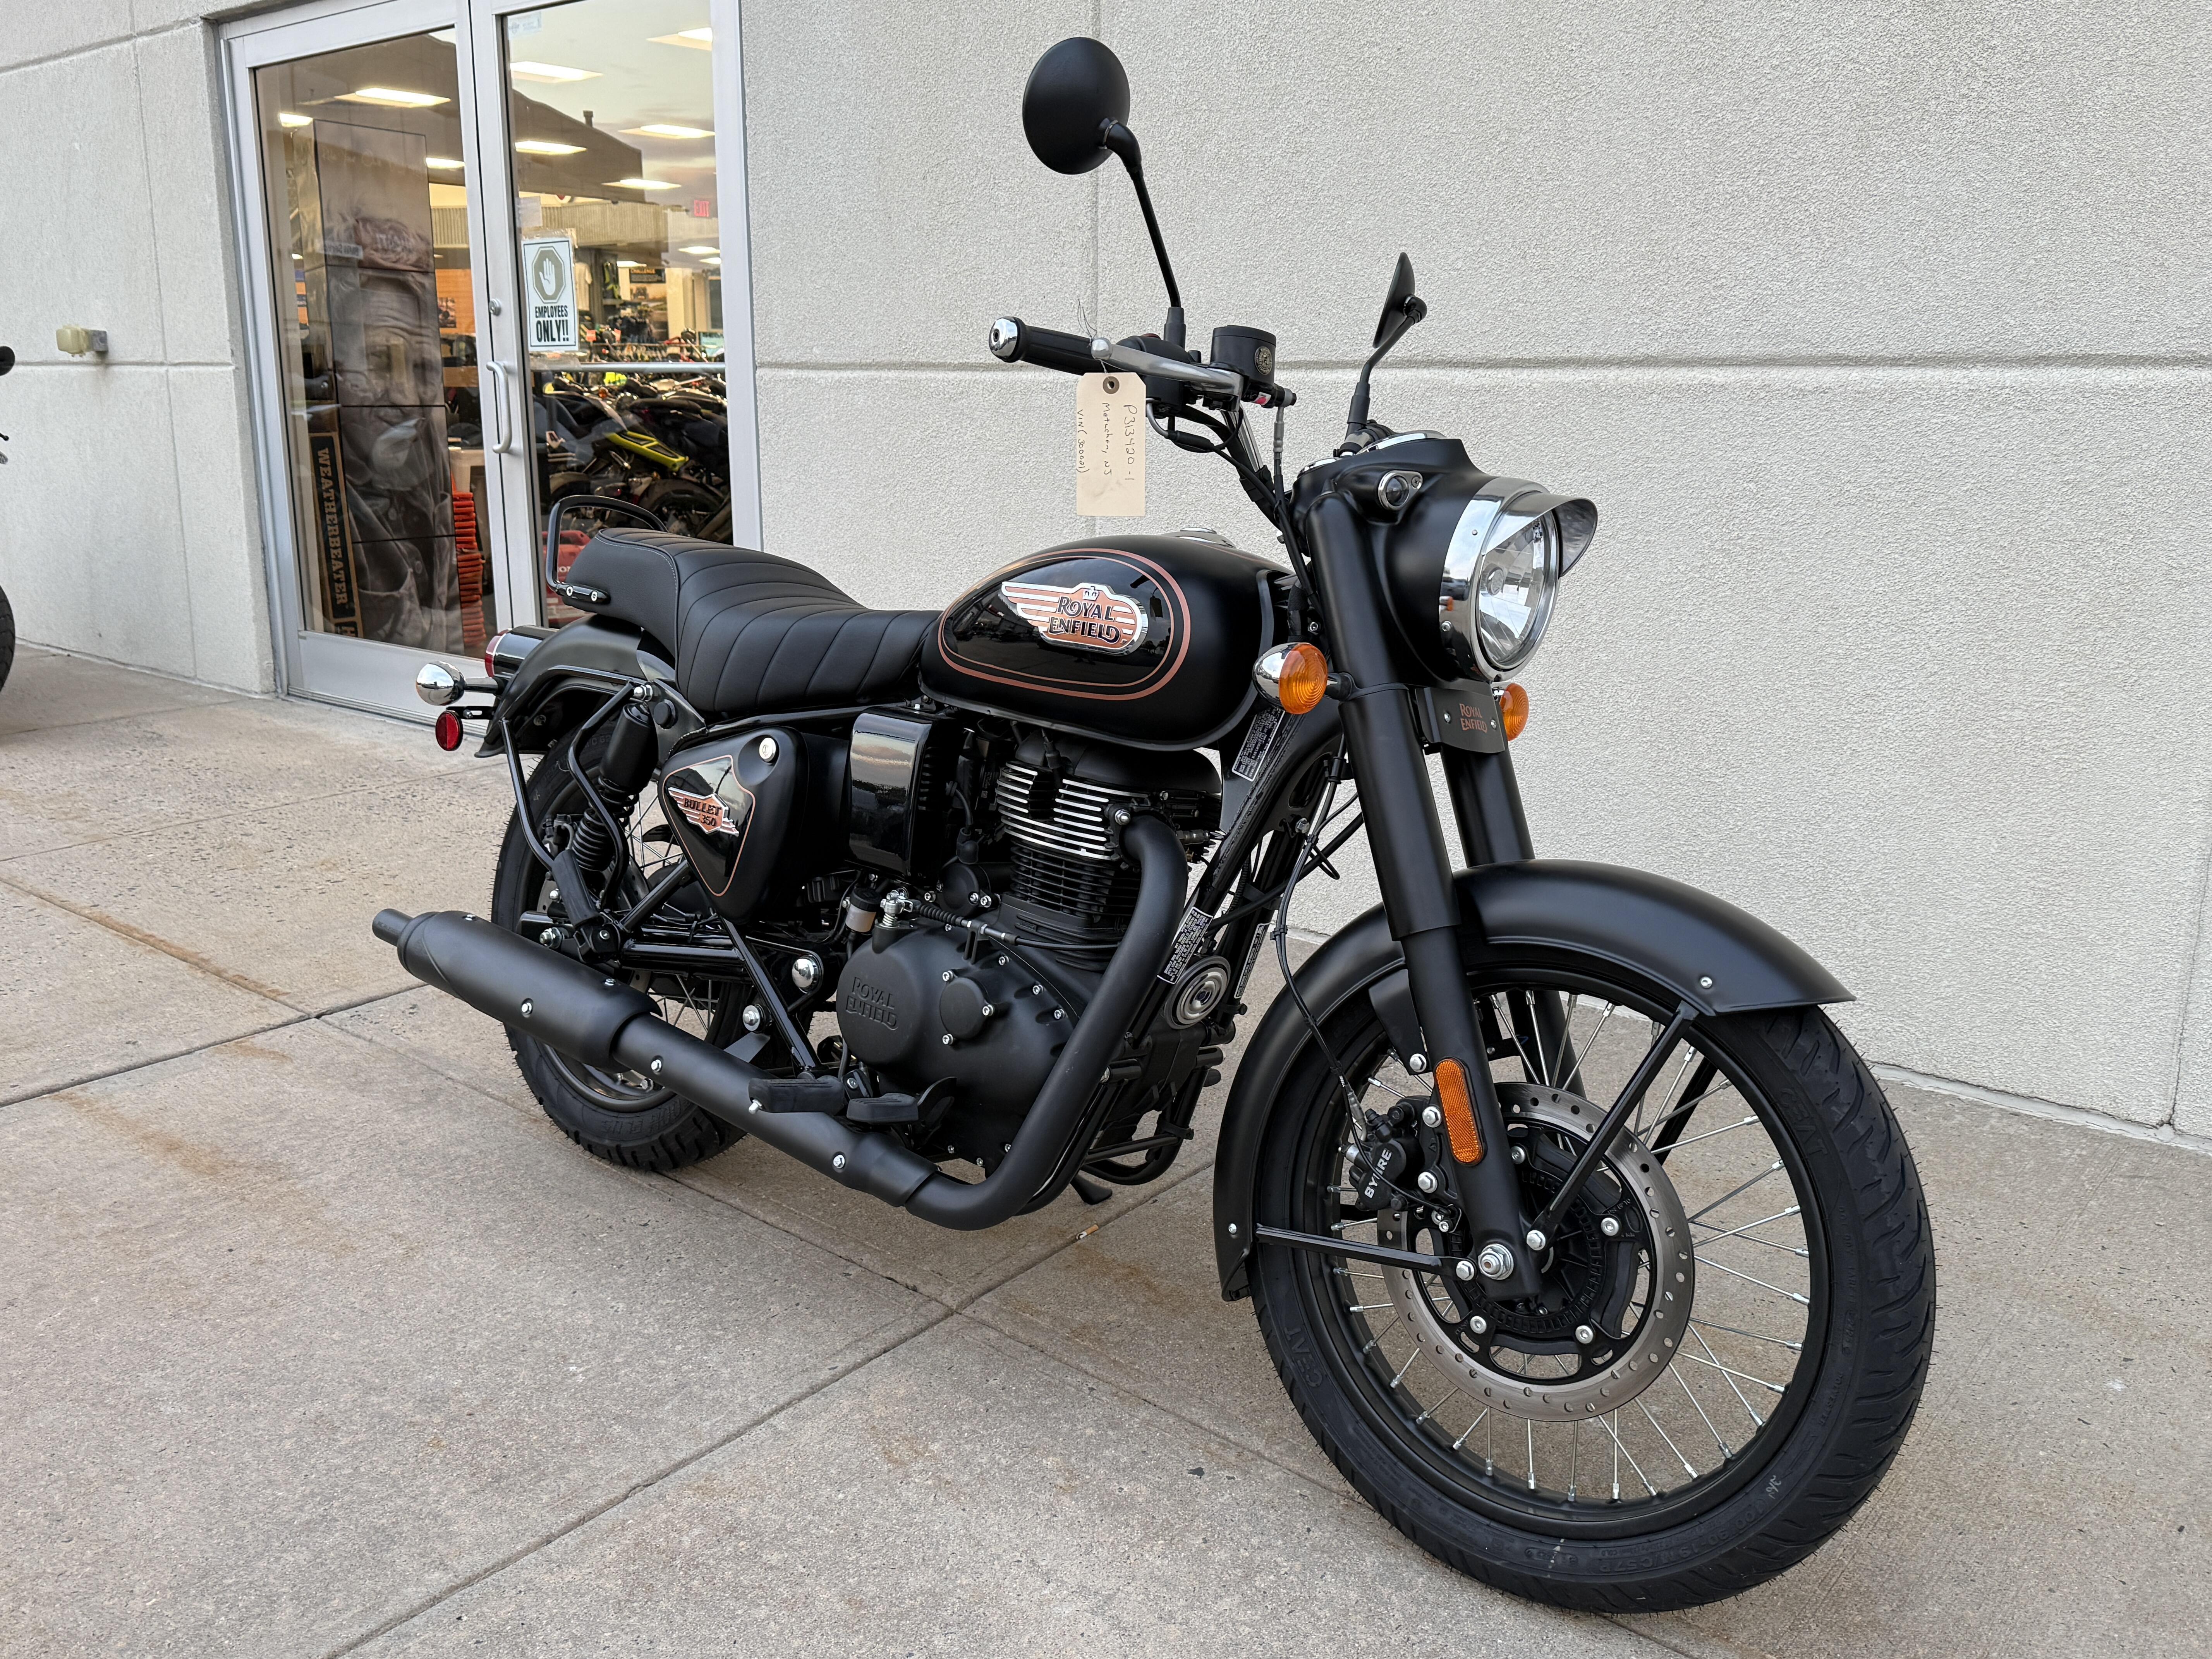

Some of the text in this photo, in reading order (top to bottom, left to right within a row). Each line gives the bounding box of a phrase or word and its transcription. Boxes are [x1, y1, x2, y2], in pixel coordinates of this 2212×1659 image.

[694, 199, 709, 217] EXIT
[535, 305, 568, 318] EMPLOYEES
[536, 319, 569, 342] ONLY!!
[1104, 460, 1112, 476] NJ
[317, 448, 348, 605] WEATHERBEATER
[1057, 596, 1115, 622] ROYAL
[1048, 617, 1121, 644] ENFIELD
[1459, 703, 1482, 718] ROYAL
[1460, 718, 1487, 733] ENFIELD
[684, 798, 722, 816] BULLET
[700, 814, 716, 826] 350
[852, 977, 895, 1010] ROYAL
[846, 995, 898, 1030] ENFIELD
